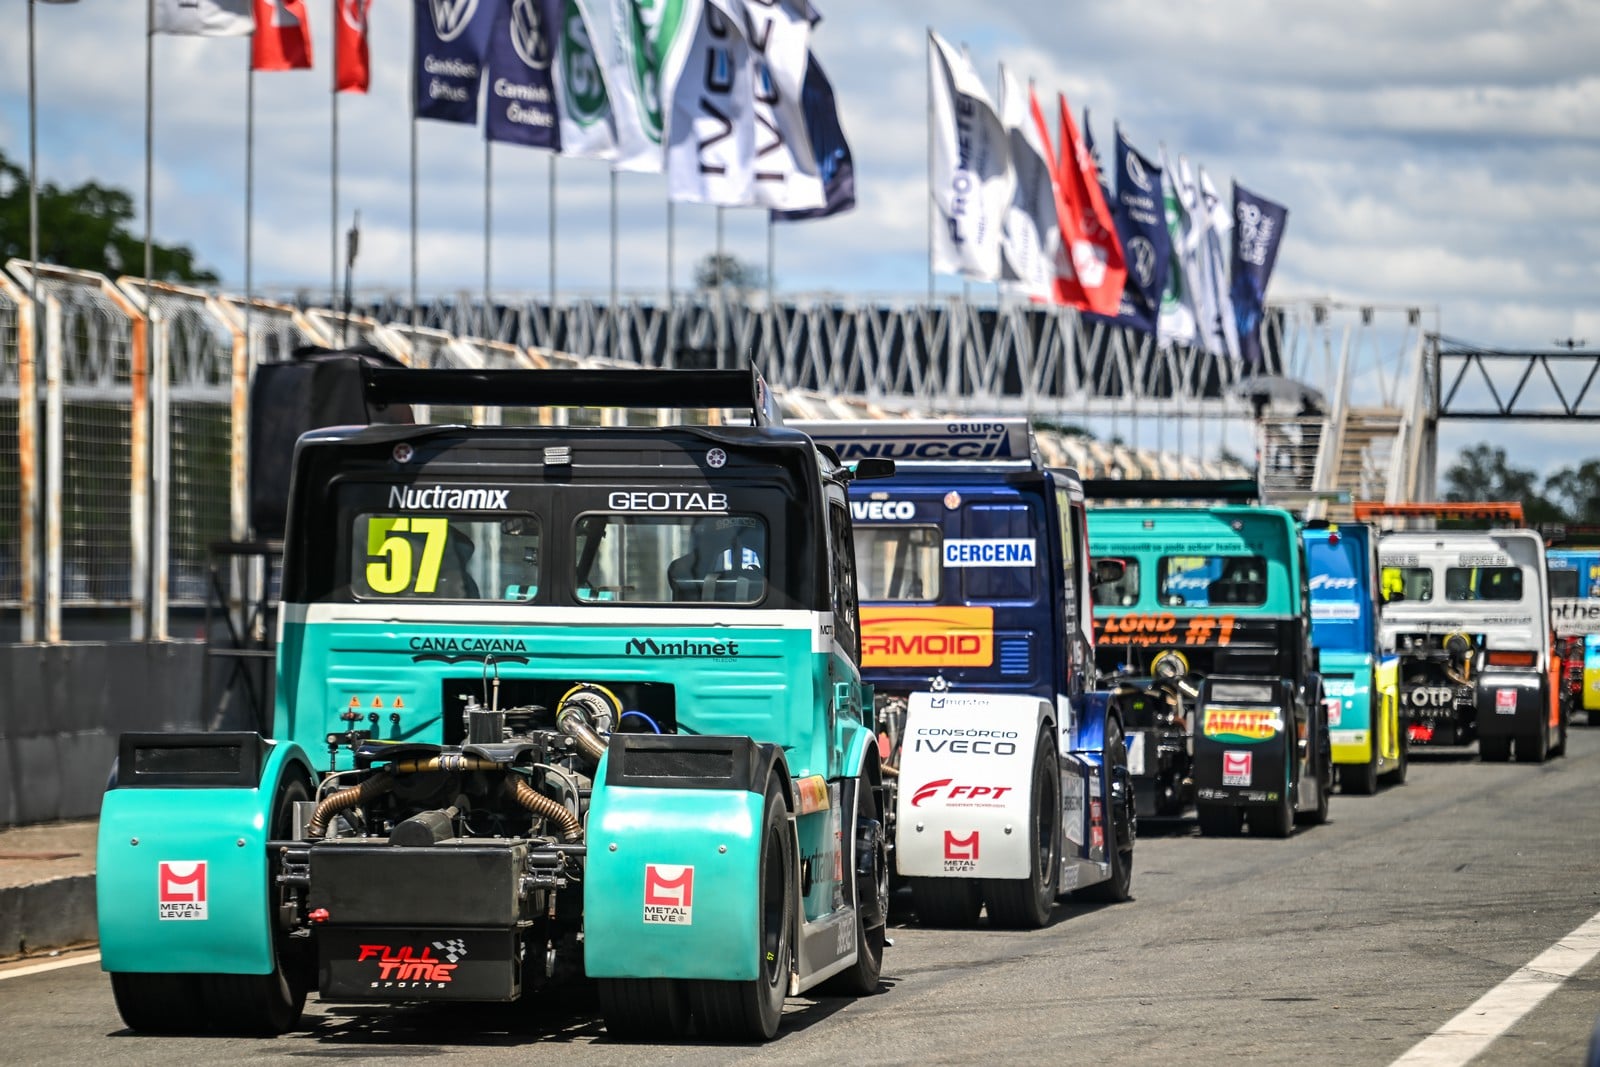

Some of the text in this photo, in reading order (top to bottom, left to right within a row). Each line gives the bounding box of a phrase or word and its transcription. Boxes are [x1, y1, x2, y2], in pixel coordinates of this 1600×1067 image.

[947, 423, 1005, 433] GRUPO
[388, 485, 510, 510] Nuctramix
[608, 492, 728, 510] GEOTAB
[366, 517, 449, 594] 57
[946, 544, 1033, 562] CERCENA
[409, 636, 527, 652] CANA CAYANA
[917, 728, 1018, 739] CONSÓRCIO
[915, 739, 1016, 756] IVECO
[947, 786, 1012, 799] FPT
[644, 906, 687, 915] METAL
[644, 914, 676, 922] LEVE
[358, 945, 439, 963] FULL
[378, 962, 458, 981] TIME
